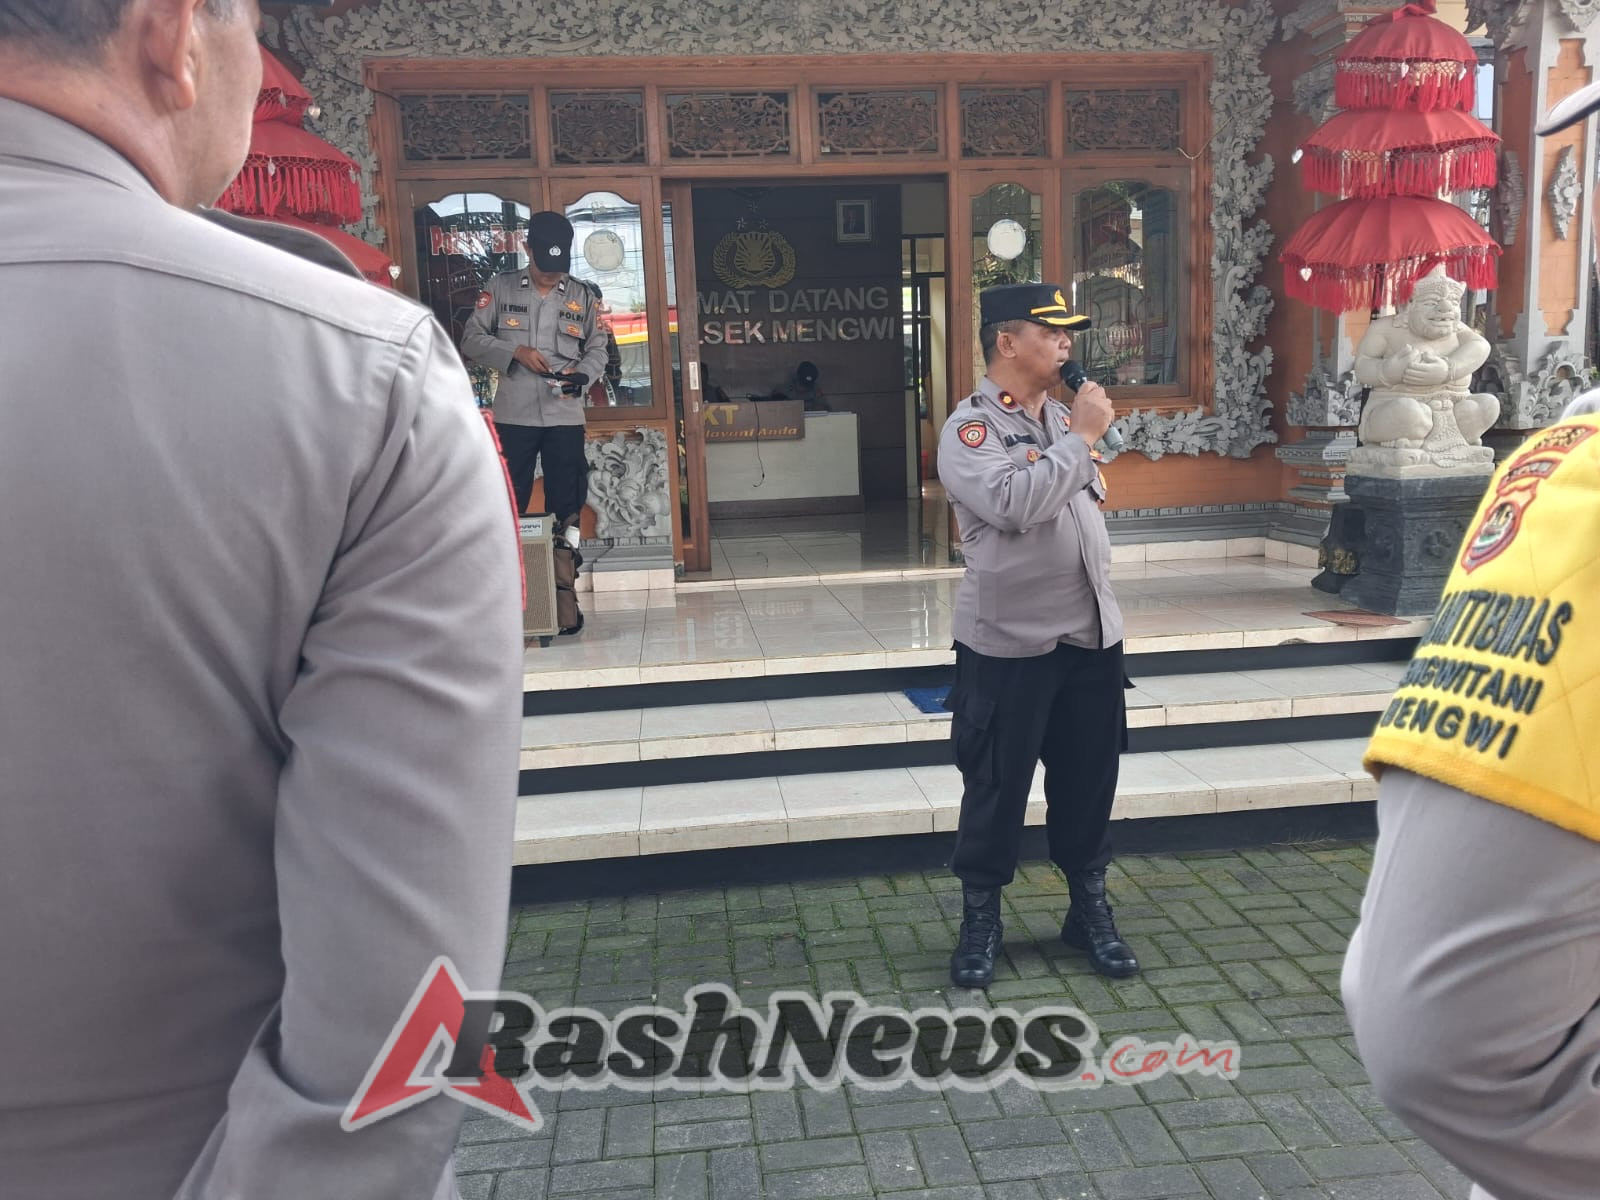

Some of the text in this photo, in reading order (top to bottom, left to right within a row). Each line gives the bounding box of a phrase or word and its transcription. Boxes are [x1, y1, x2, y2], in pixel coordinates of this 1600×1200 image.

[768, 287, 888, 313] DATANG
[560, 310, 584, 321] POLRI
[698, 316, 895, 344] SEK MENGWI
[758, 426, 798, 437] Anda
